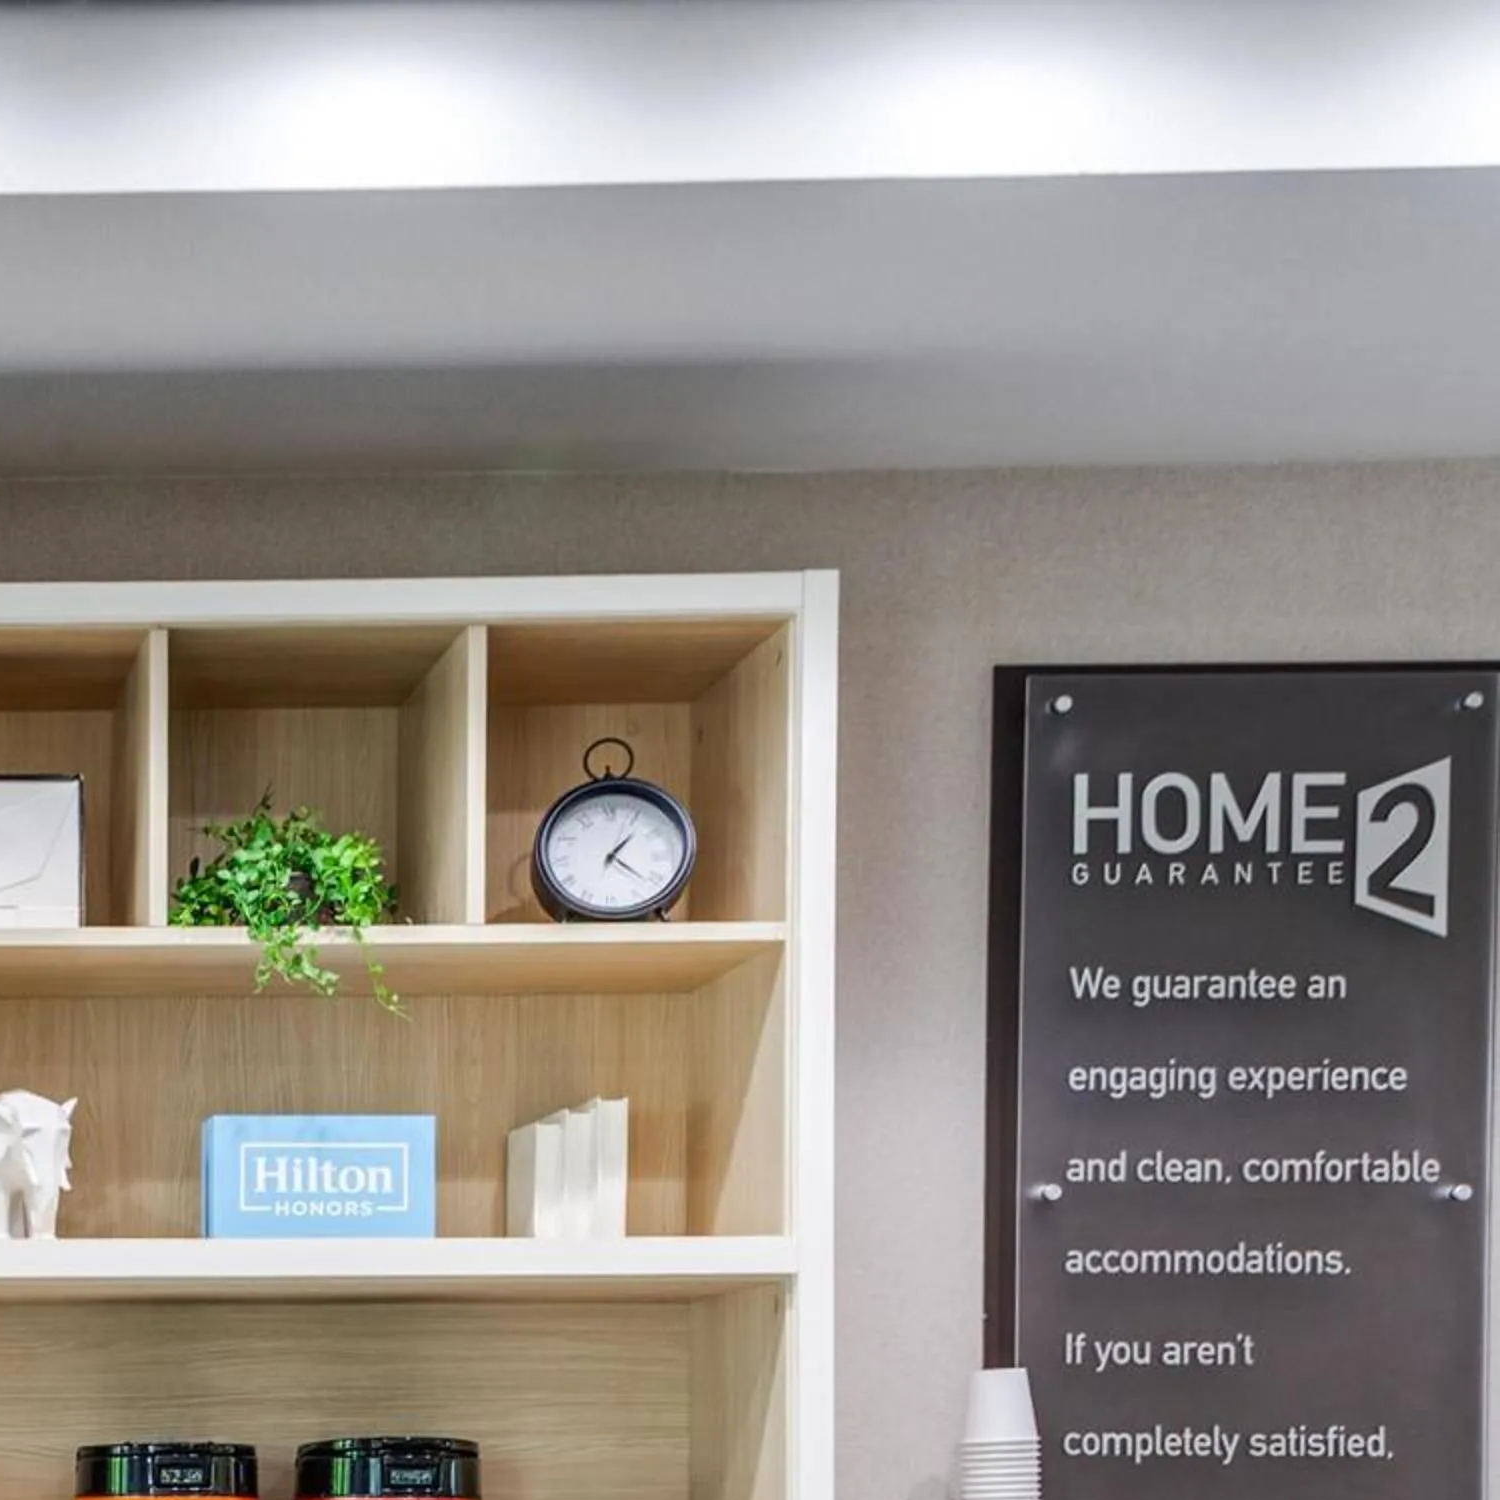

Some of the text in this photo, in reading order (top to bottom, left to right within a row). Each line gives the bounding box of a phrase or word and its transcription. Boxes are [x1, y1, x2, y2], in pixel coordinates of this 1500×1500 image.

[1073, 772, 1440, 922] HOME 2
[1072, 862, 1345, 886] GUARANTEE
[1069, 967, 1347, 1007] We guarantee an
[1068, 1058, 1408, 1099] engaging experience
[253, 1155, 394, 1195] Hilton
[1066, 1150, 1441, 1184] and clean, comfortable
[274, 1200, 375, 1217] HONORS
[1065, 1241, 1352, 1275] accommodations.
[1065, 1332, 1254, 1373] If you aren't
[1063, 1424, 1394, 1465] completely satisfied,
